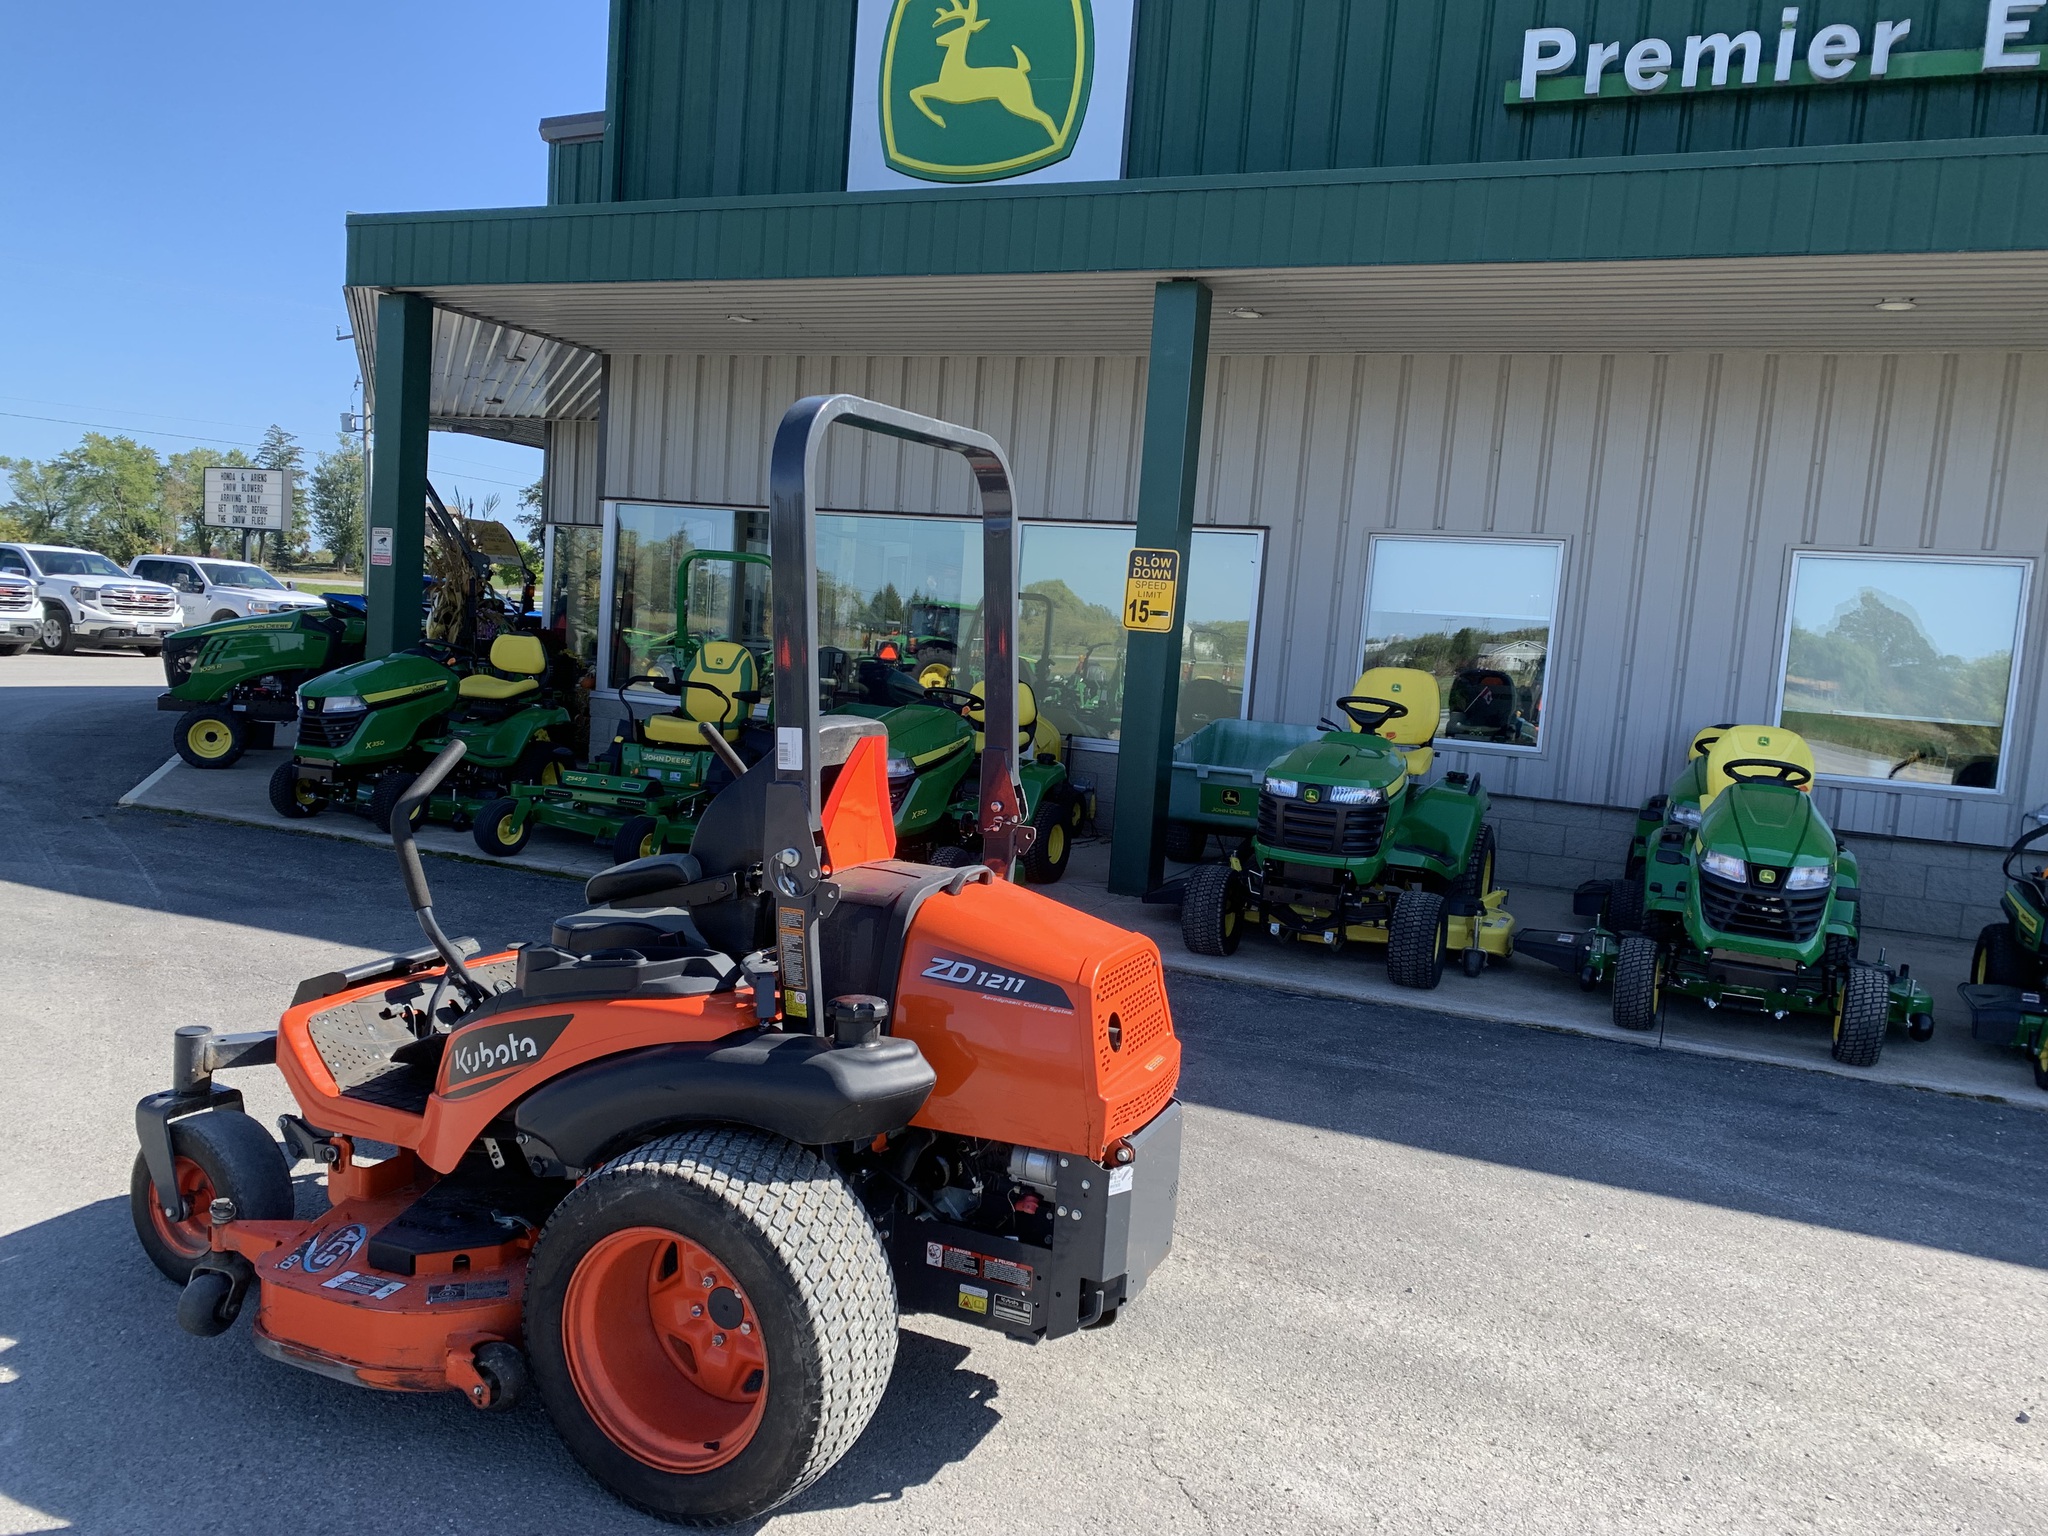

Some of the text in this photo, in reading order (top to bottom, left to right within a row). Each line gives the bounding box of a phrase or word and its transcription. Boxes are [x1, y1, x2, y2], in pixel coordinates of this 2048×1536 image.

[1519, 6, 1912, 100] Premier
[221, 472, 267, 482] HONDA & ARIENS
[223, 482, 263, 493] SNOW BLOWERS
[221, 494, 260, 503] ARRIVING DAILY
[218, 503, 268, 514] GET YOURS BEFORE
[217, 514, 226, 524] THE
[232, 515, 246, 525] SNOW
[1134, 556, 1172, 568] SLOW
[1132, 567, 1172, 580] DOWN
[1135, 580, 1167, 591] SPEED
[1137, 591, 1162, 599] LIMIT
[1128, 599, 1150, 623] 15
[642, 753, 692, 765] JOHN DEERE
[1211, 806, 1251, 816] JOHN DEERE
[982, 994, 1022, 1006] Aerodynamic
[1023, 1002, 1048, 1012] Cutting
[454, 1032, 538, 1075] Kubota
[313, 1228, 362, 1267] ACS
[953, 1247, 973, 1256] DANGER
[998, 1258, 1018, 1268] PELIGRO
